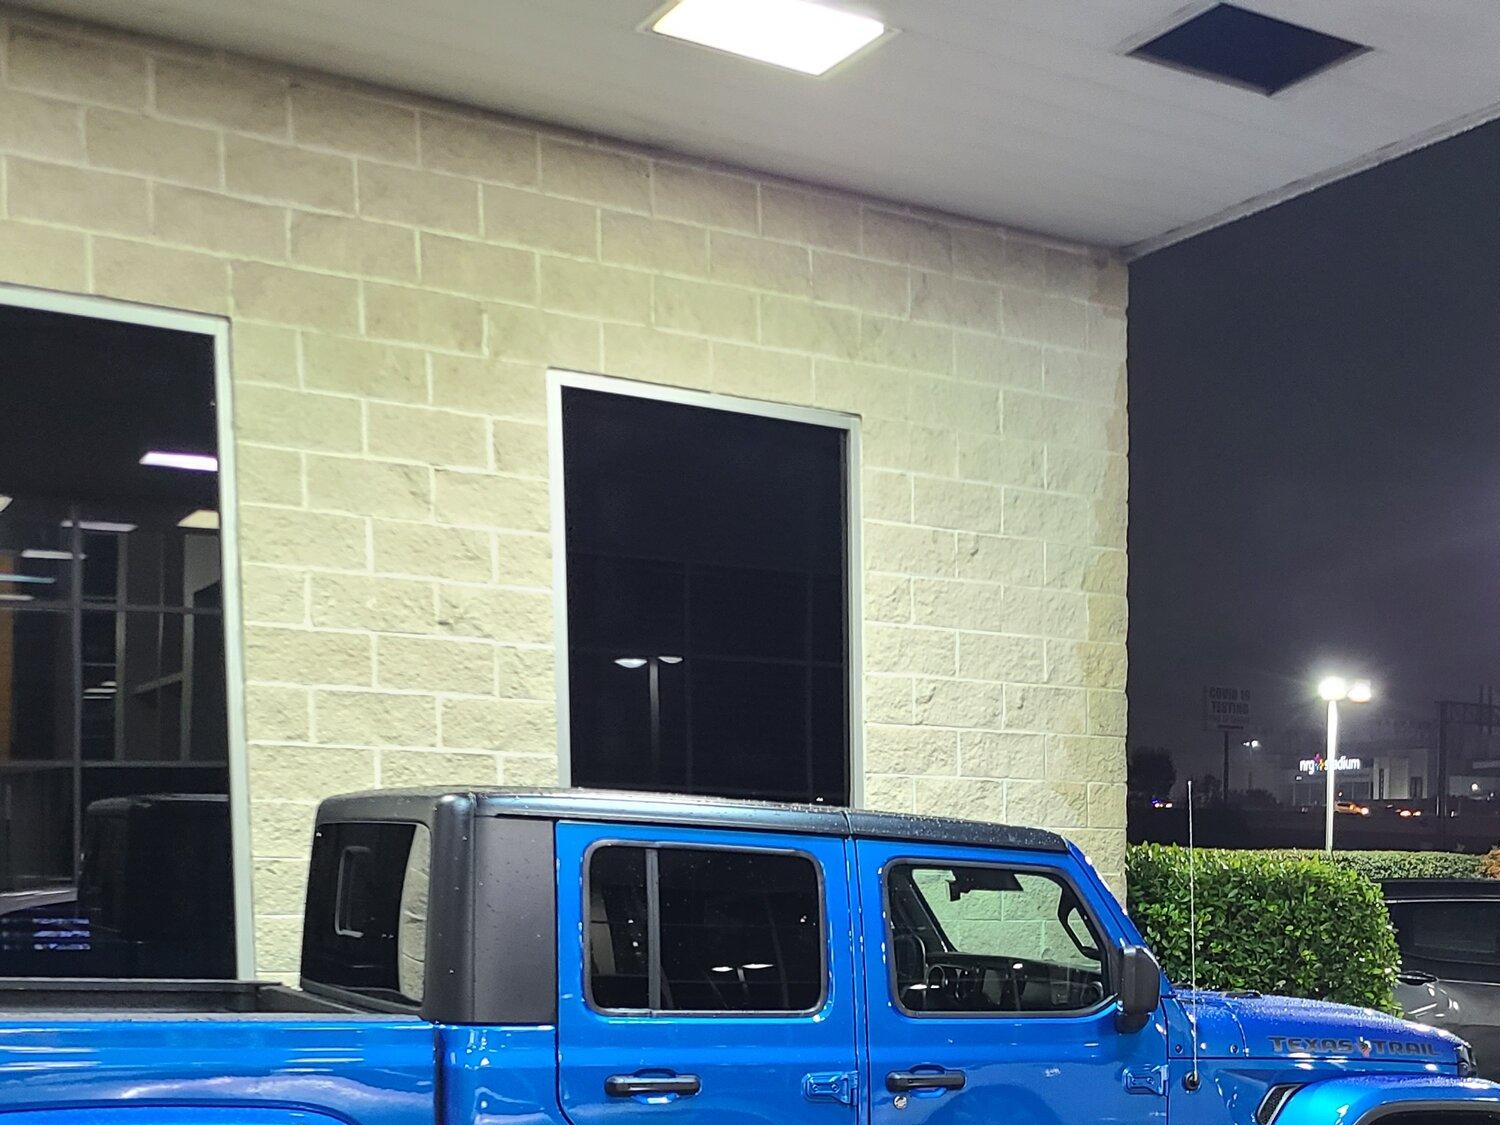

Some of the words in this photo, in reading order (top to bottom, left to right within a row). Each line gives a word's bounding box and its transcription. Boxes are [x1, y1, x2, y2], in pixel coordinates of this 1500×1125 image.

[1299, 759, 1315, 775] nrg
[1268, 1035, 1353, 1054] TEXAS
[1370, 1039, 1439, 1057] TRAIL
